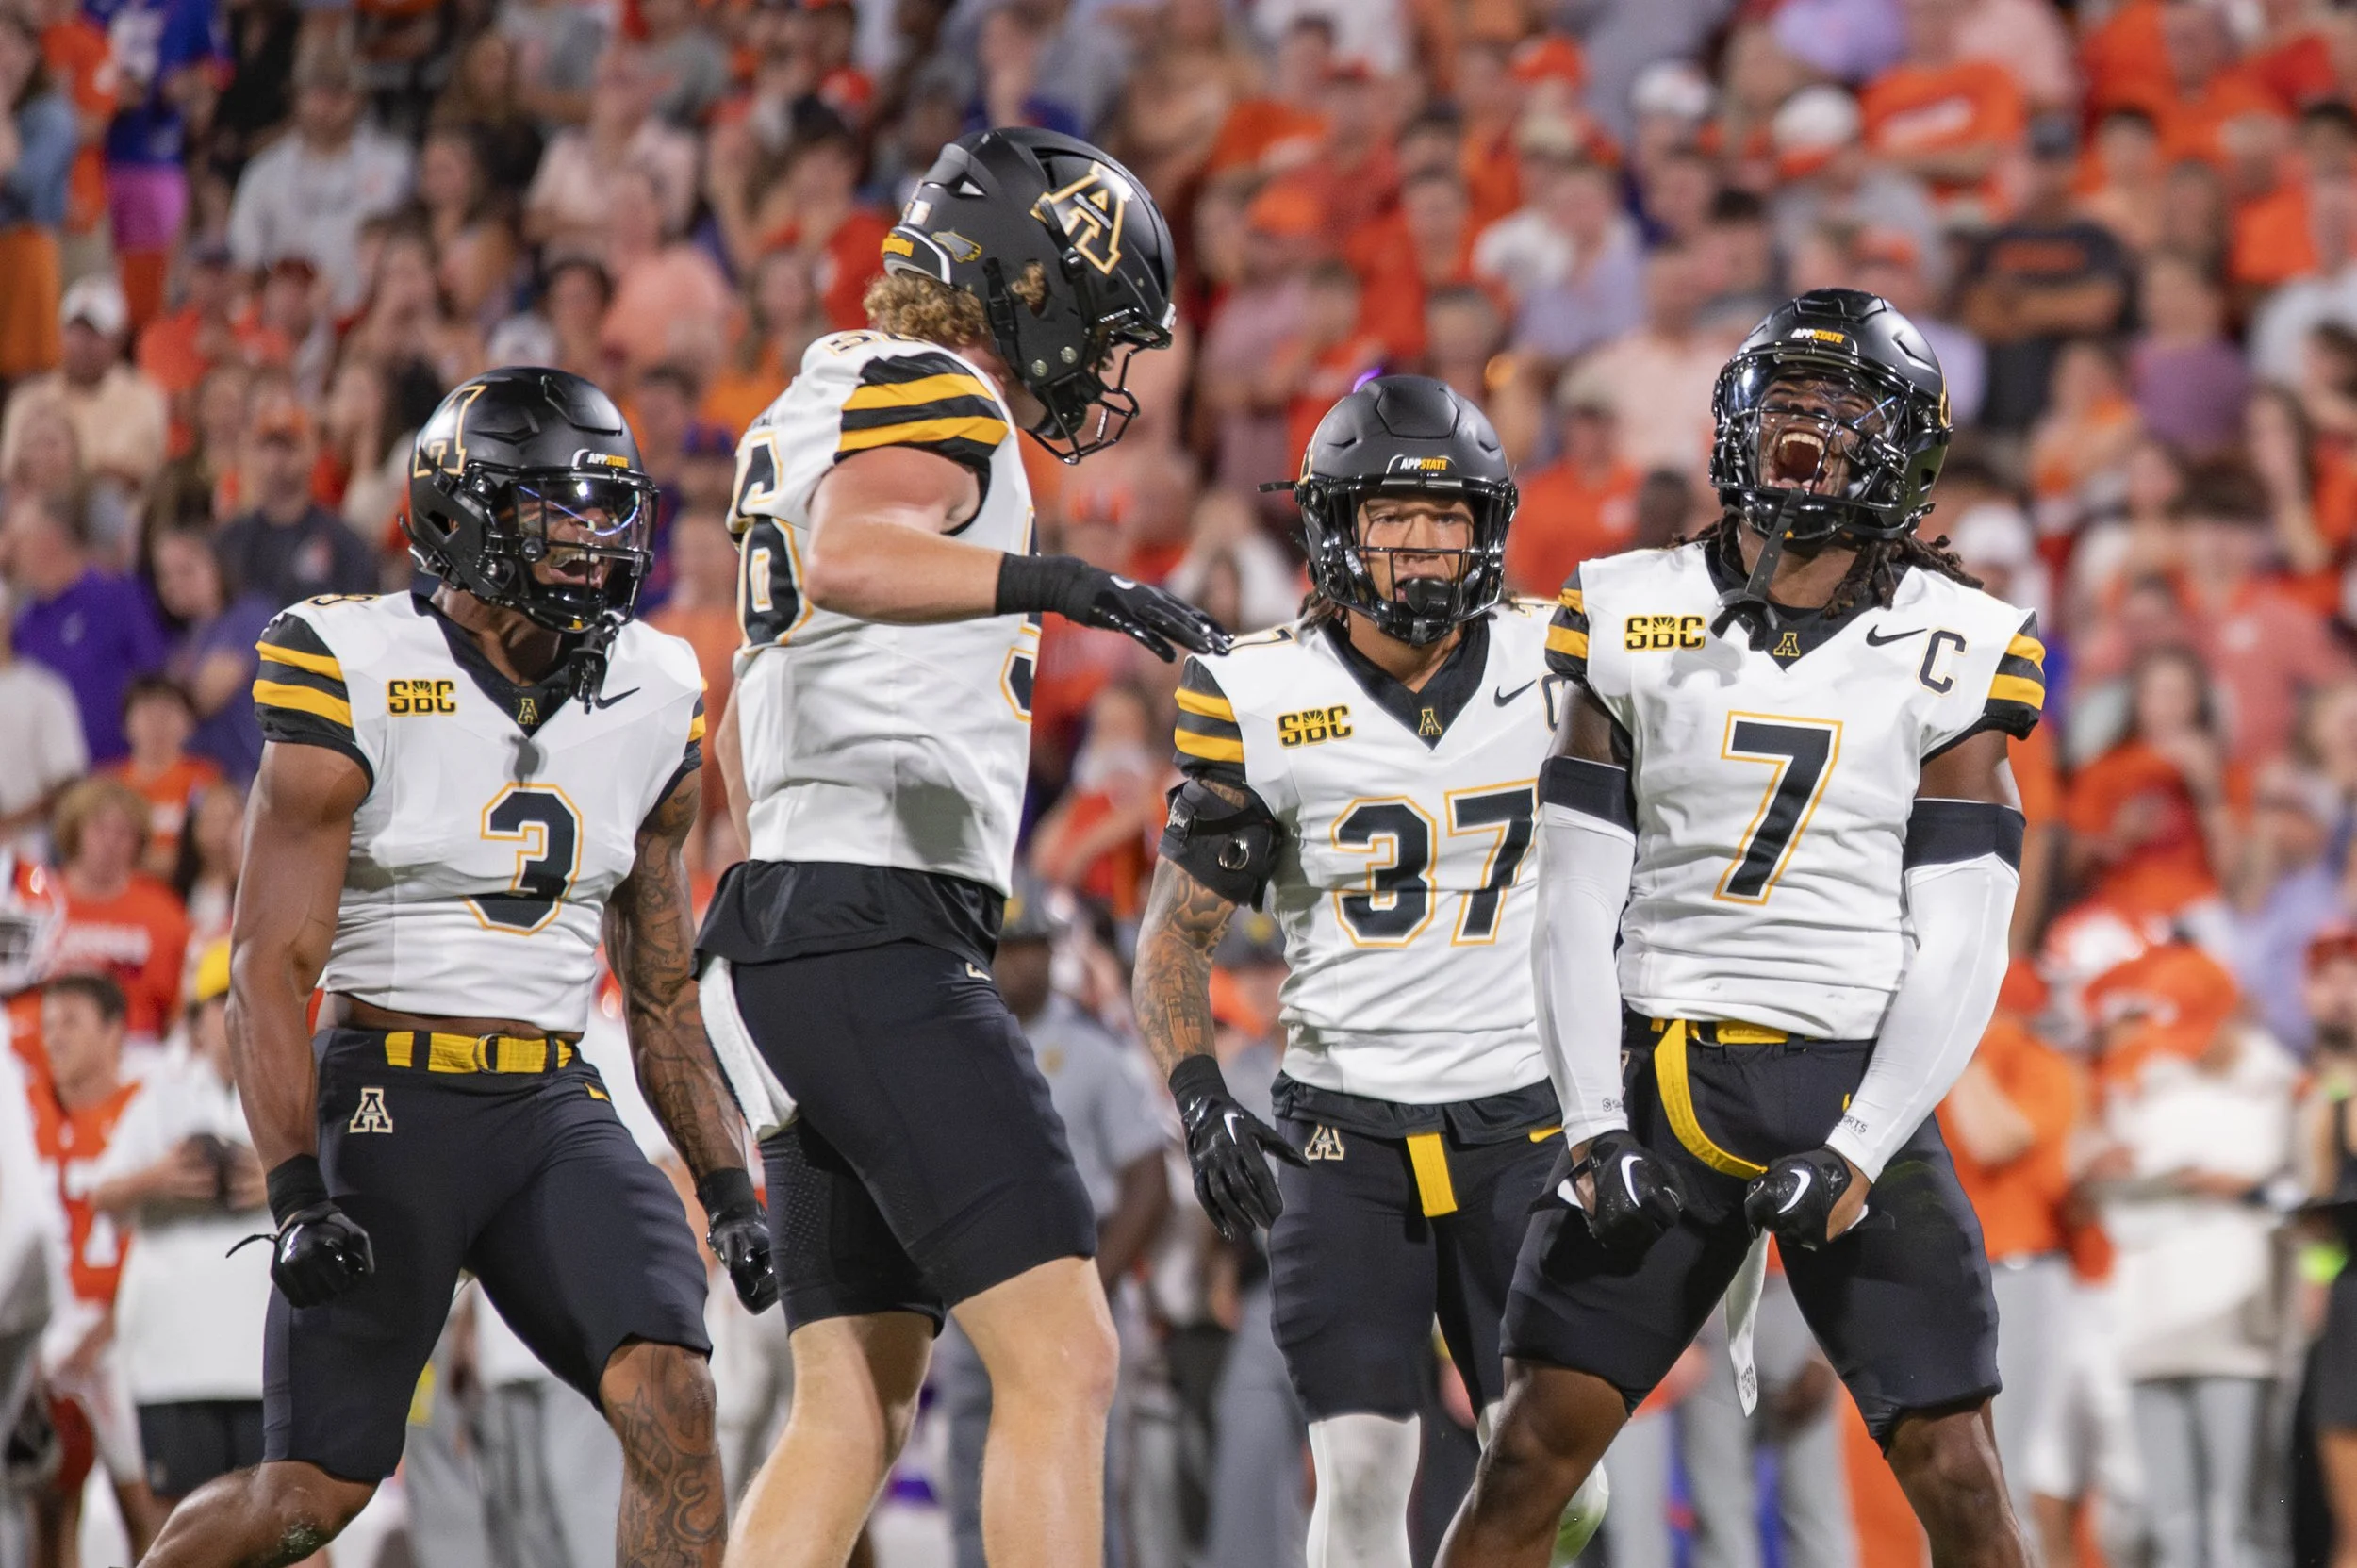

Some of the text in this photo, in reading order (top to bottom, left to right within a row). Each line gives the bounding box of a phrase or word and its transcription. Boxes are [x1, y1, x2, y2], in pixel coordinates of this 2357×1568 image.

[1031, 160, 1131, 274] A
[1624, 615, 1706, 652] SBC
[1773, 633, 1801, 657] A
[1917, 627, 1972, 697] C
[387, 679, 457, 717] SBC
[518, 698, 539, 725] A
[1277, 704, 1354, 749] SBC
[1419, 708, 1442, 736] A
[1712, 710, 1843, 906] 7
[462, 782, 583, 936] 3
[1330, 778, 1539, 948] 37
[349, 1088, 393, 1133] A
[1304, 1124, 1345, 1161] A
